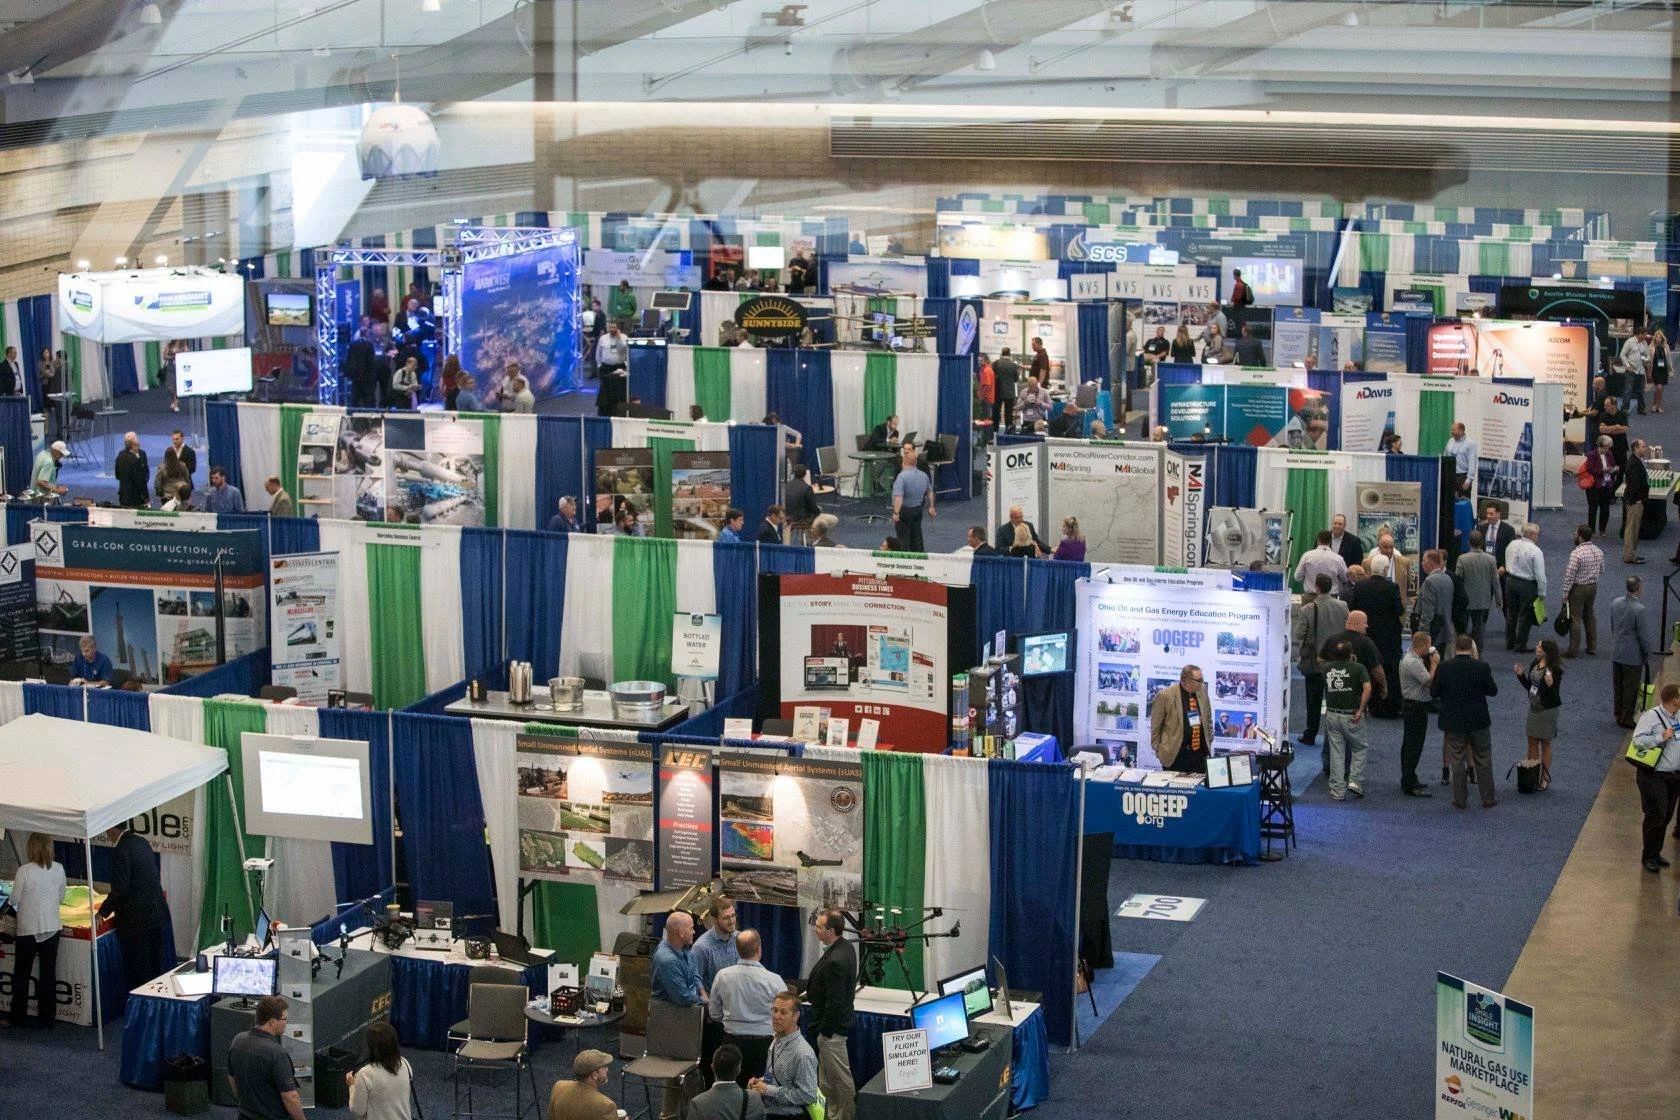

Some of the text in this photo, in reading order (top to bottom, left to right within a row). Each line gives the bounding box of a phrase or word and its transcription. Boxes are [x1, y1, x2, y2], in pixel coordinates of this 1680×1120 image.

[1091, 247, 1127, 261] SCS
[743, 318, 800, 328] SUNNYSIDE
[1006, 452, 1032, 468] ORC
[1054, 451, 1154, 462] www.OhioRiverCorridor.com
[1167, 461, 1179, 477] ORC
[72, 540, 239, 556] GRAE-CON CONSTRUCTION, INC.
[66, 571, 104, 579] CONTRACTORS
[858, 578, 888, 586] PITTSBURGH
[877, 585, 894, 593] TIMES
[864, 602, 906, 611] CONNECTION.
[1098, 603, 1260, 621] Ohio Oil and Gas Energy Education Program
[1152, 628, 1204, 648] OOGEEP
[517, 740, 651, 758] Small Unmanned Aerial Systems (sUAS)
[720, 758, 862, 777] Small Unmanned Aerial Systems (sUAS)
[1122, 792, 1188, 818] OOGEEP
[673, 821, 698, 830] Practices
[162, 842, 190, 851] LIGHT
[1142, 897, 1183, 918] 700
[1469, 1012, 1499, 1031] INSIGHT
[1474, 1008, 1493, 1020] SHALE
[906, 1033, 921, 1041] OUR
[894, 1042, 919, 1050] FLIGHT
[888, 1049, 927, 1060] SIMULATOR
[897, 1059, 918, 1067] HERE!
[1441, 1041, 1529, 1086] NATURAL GAS USE
[1450, 1057, 1520, 1096] MARKETPLACE
[1441, 1093, 1467, 1109] REPSOL
[1466, 1097, 1498, 1118] Geisinger
